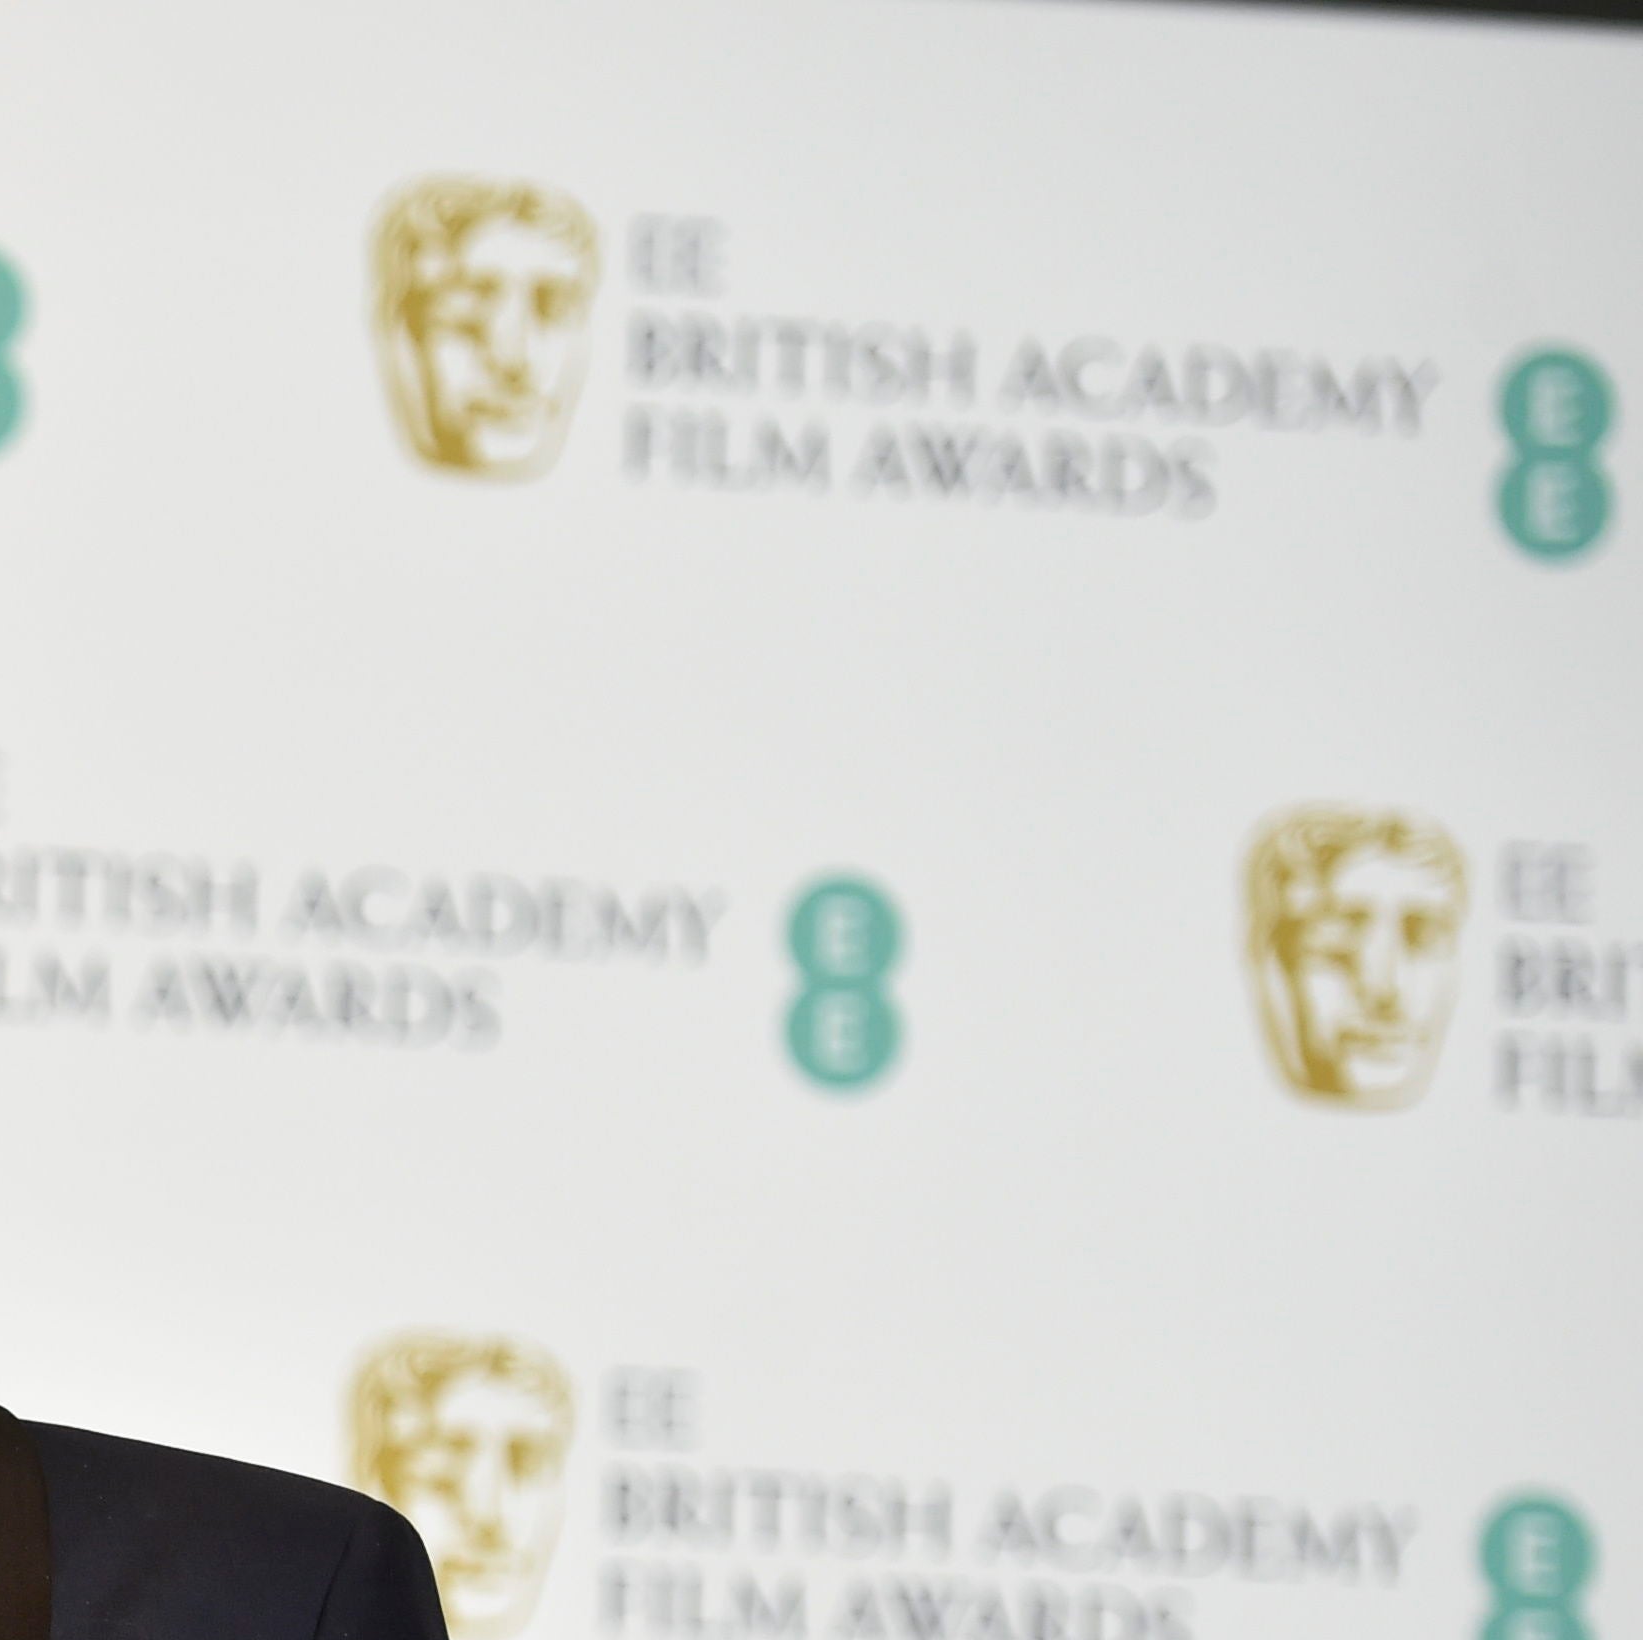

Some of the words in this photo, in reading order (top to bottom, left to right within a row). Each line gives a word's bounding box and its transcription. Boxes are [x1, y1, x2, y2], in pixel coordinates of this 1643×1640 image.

[625, 313, 975, 401] BRITISH
[998, 337, 1440, 437] ACADEMY
[623, 408, 831, 493] FILM
[851, 432, 1216, 520] AWARDS
[284, 870, 724, 966] ACADEMY
[134, 961, 502, 1049] AWARDS
[1499, 937, 1643, 1021] BRI
[1497, 1034, 1643, 1117] FIL
[603, 1465, 952, 1557] BRITISH
[983, 1486, 1418, 1584] ACADEMY
